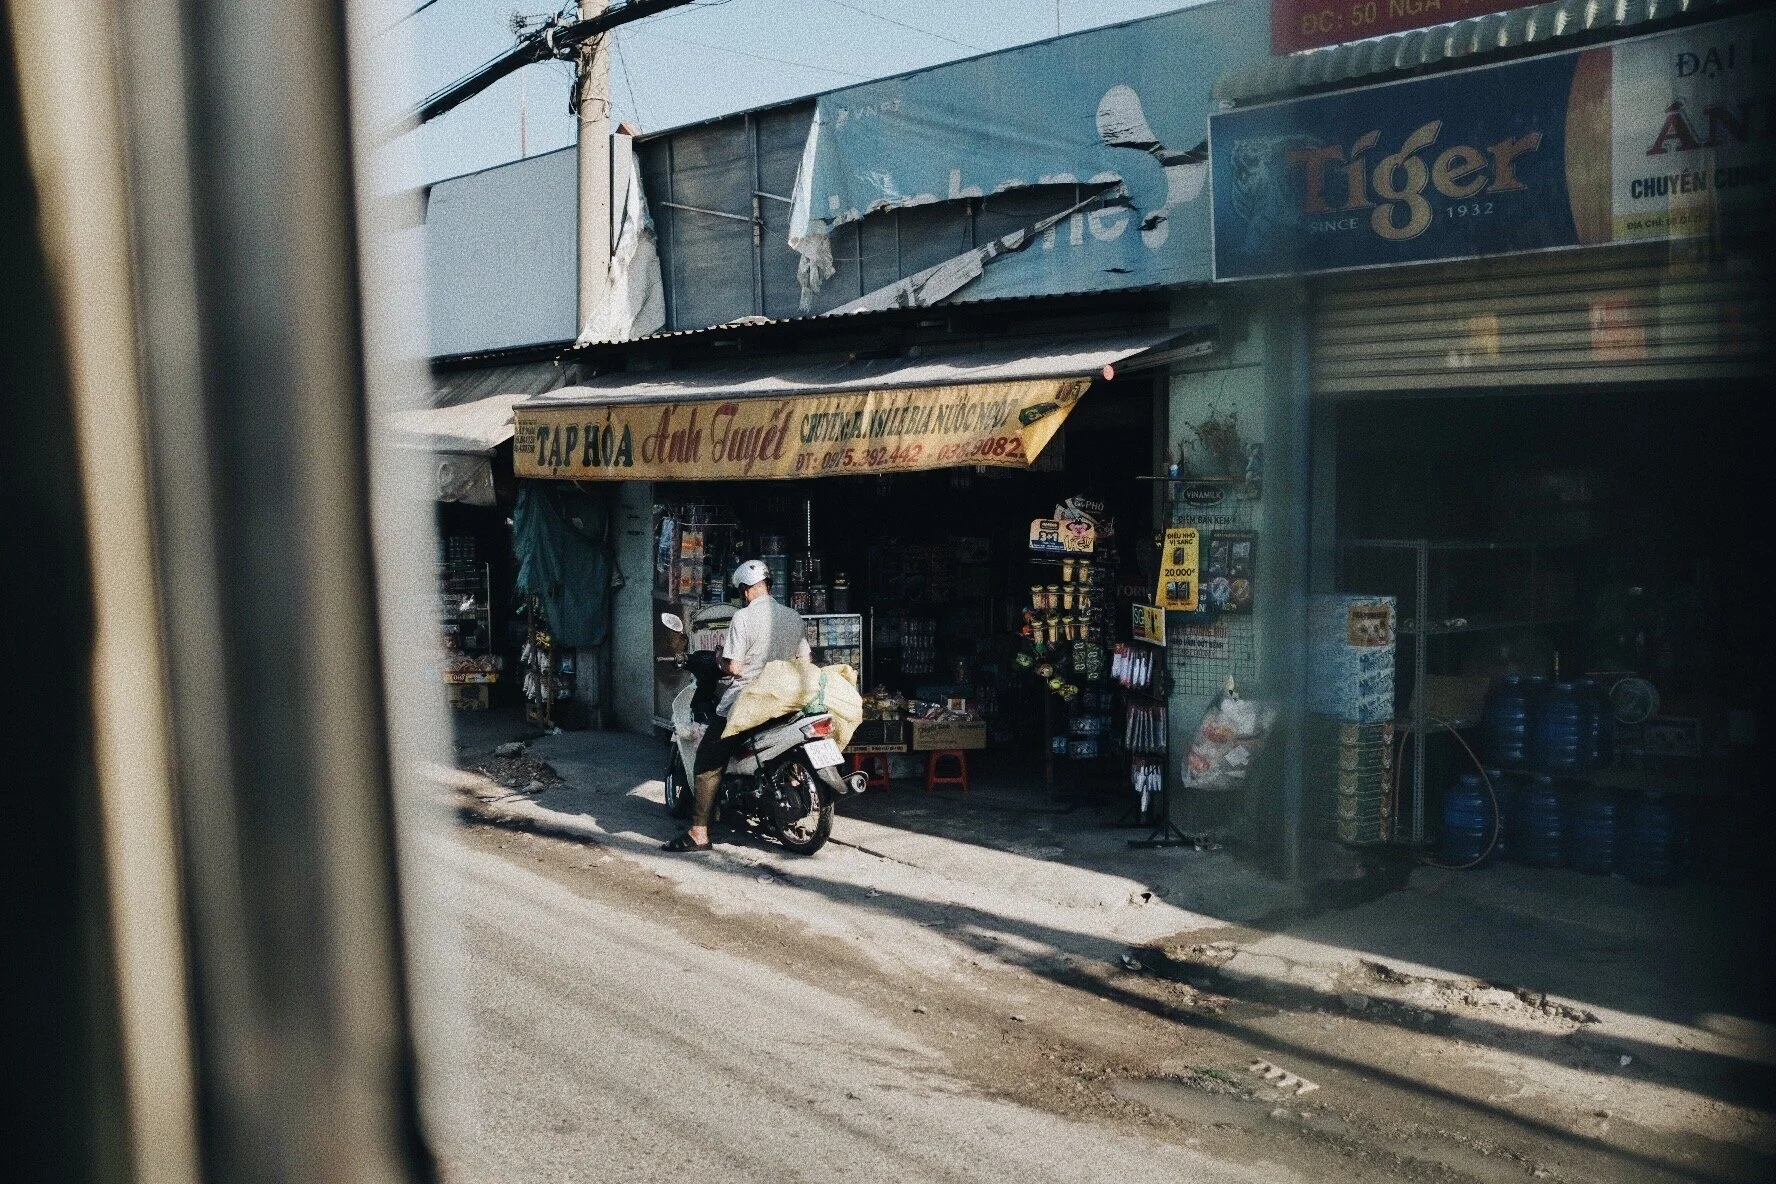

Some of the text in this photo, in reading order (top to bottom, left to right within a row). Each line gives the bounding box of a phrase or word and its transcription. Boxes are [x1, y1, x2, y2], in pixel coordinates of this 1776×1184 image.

[1351, 4, 1377, 26] 50
[1284, 119, 1543, 242] Tiger
[1308, 202, 1494, 236] SINCE 1932
[904, 404, 934, 436] BIA
[536, 422, 580, 475] TẠP
[641, 401, 795, 476] Ánh Tuyết
[795, 451, 818, 473] ĐT:
[1186, 490, 1222, 499] VINAMILK
